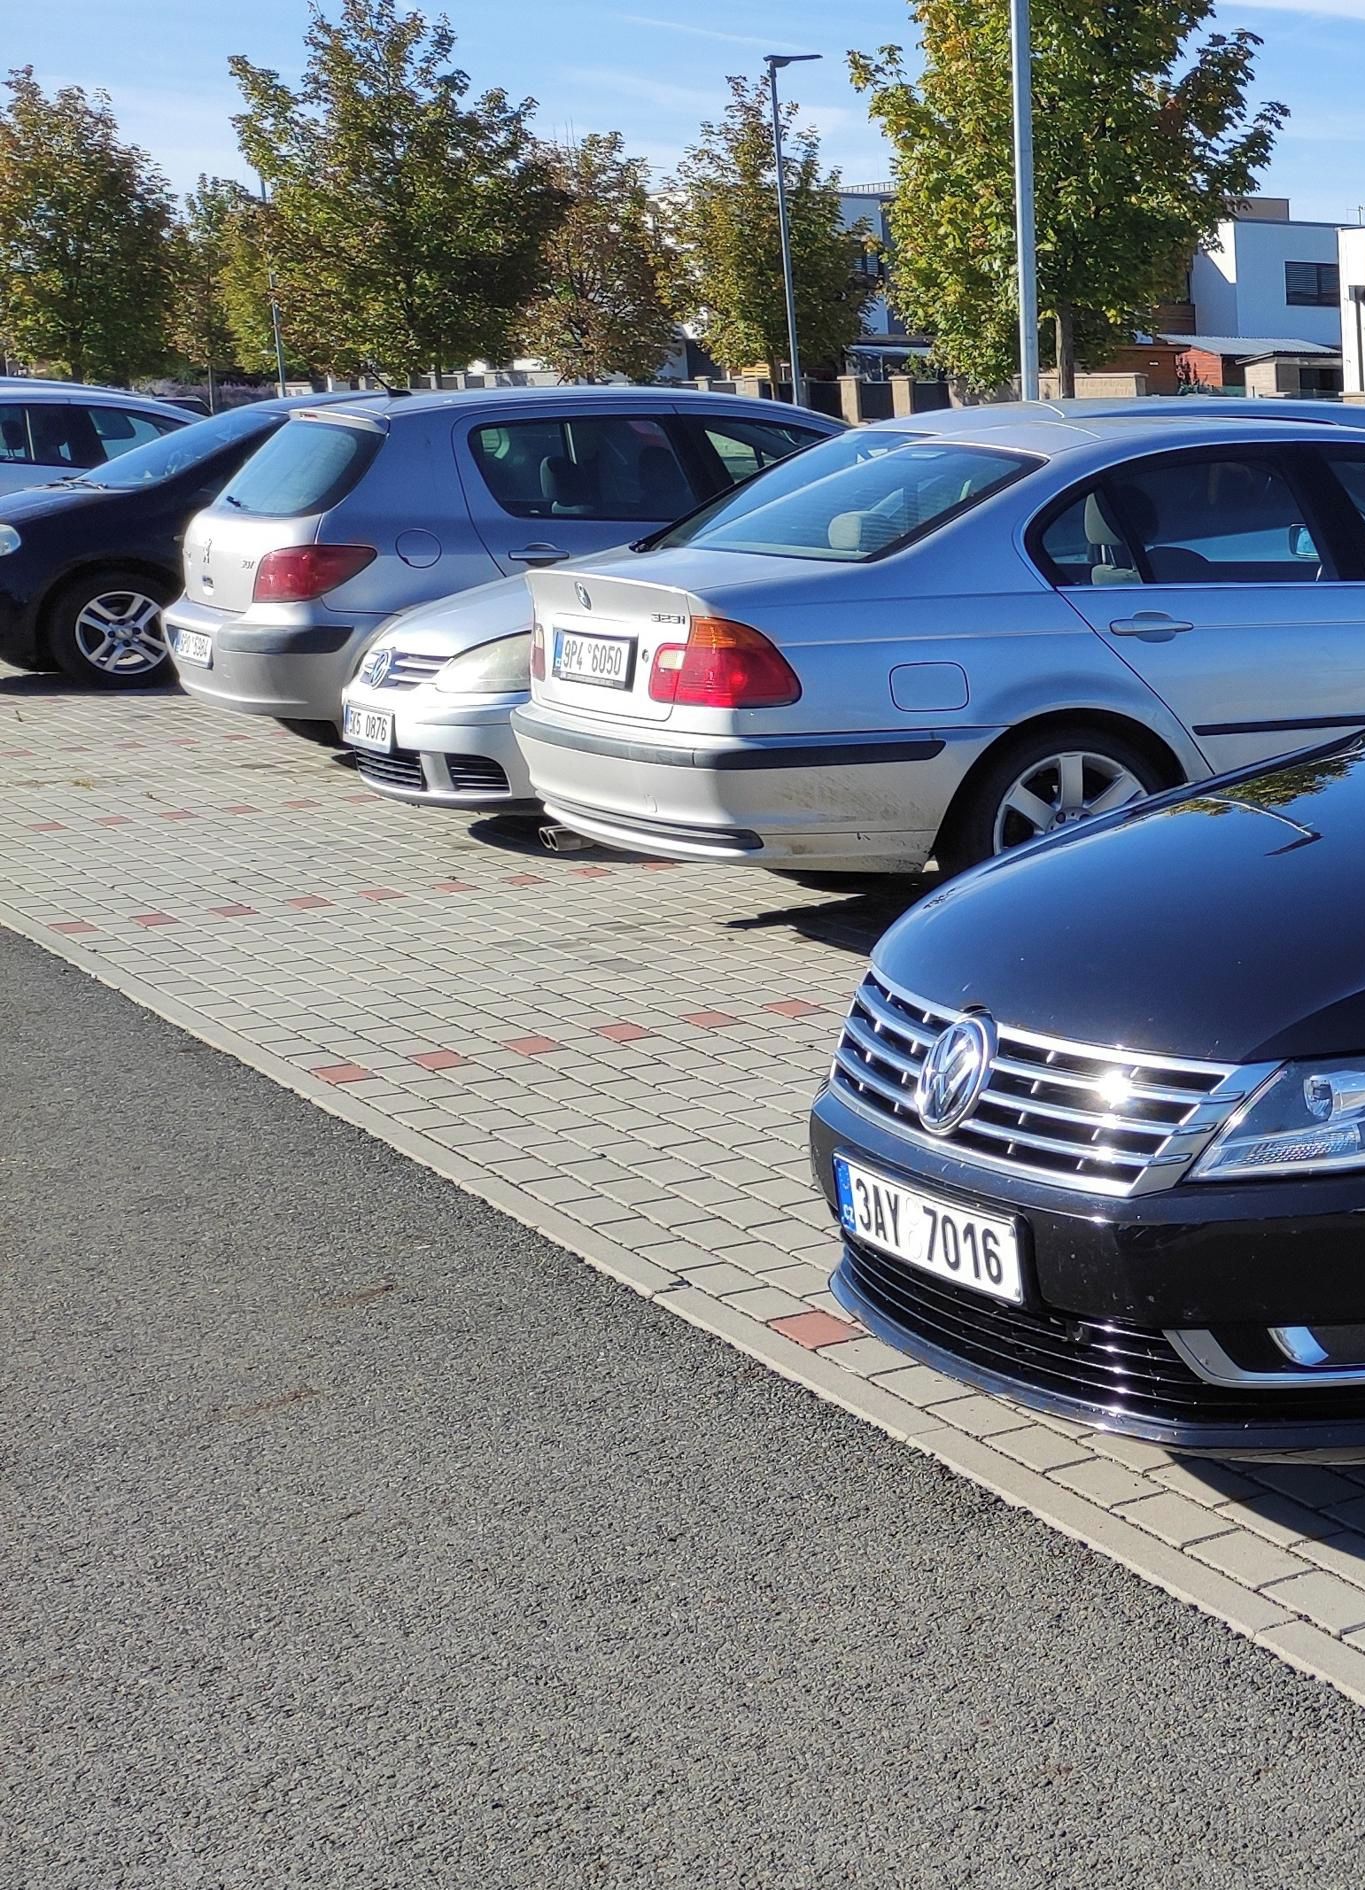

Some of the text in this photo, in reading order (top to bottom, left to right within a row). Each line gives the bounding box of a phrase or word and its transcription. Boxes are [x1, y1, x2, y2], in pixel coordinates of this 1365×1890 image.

[563, 639, 622, 676] 9P4 6050
[366, 714, 388, 742] 0876
[856, 1178, 1001, 1286] 3AY 7016
